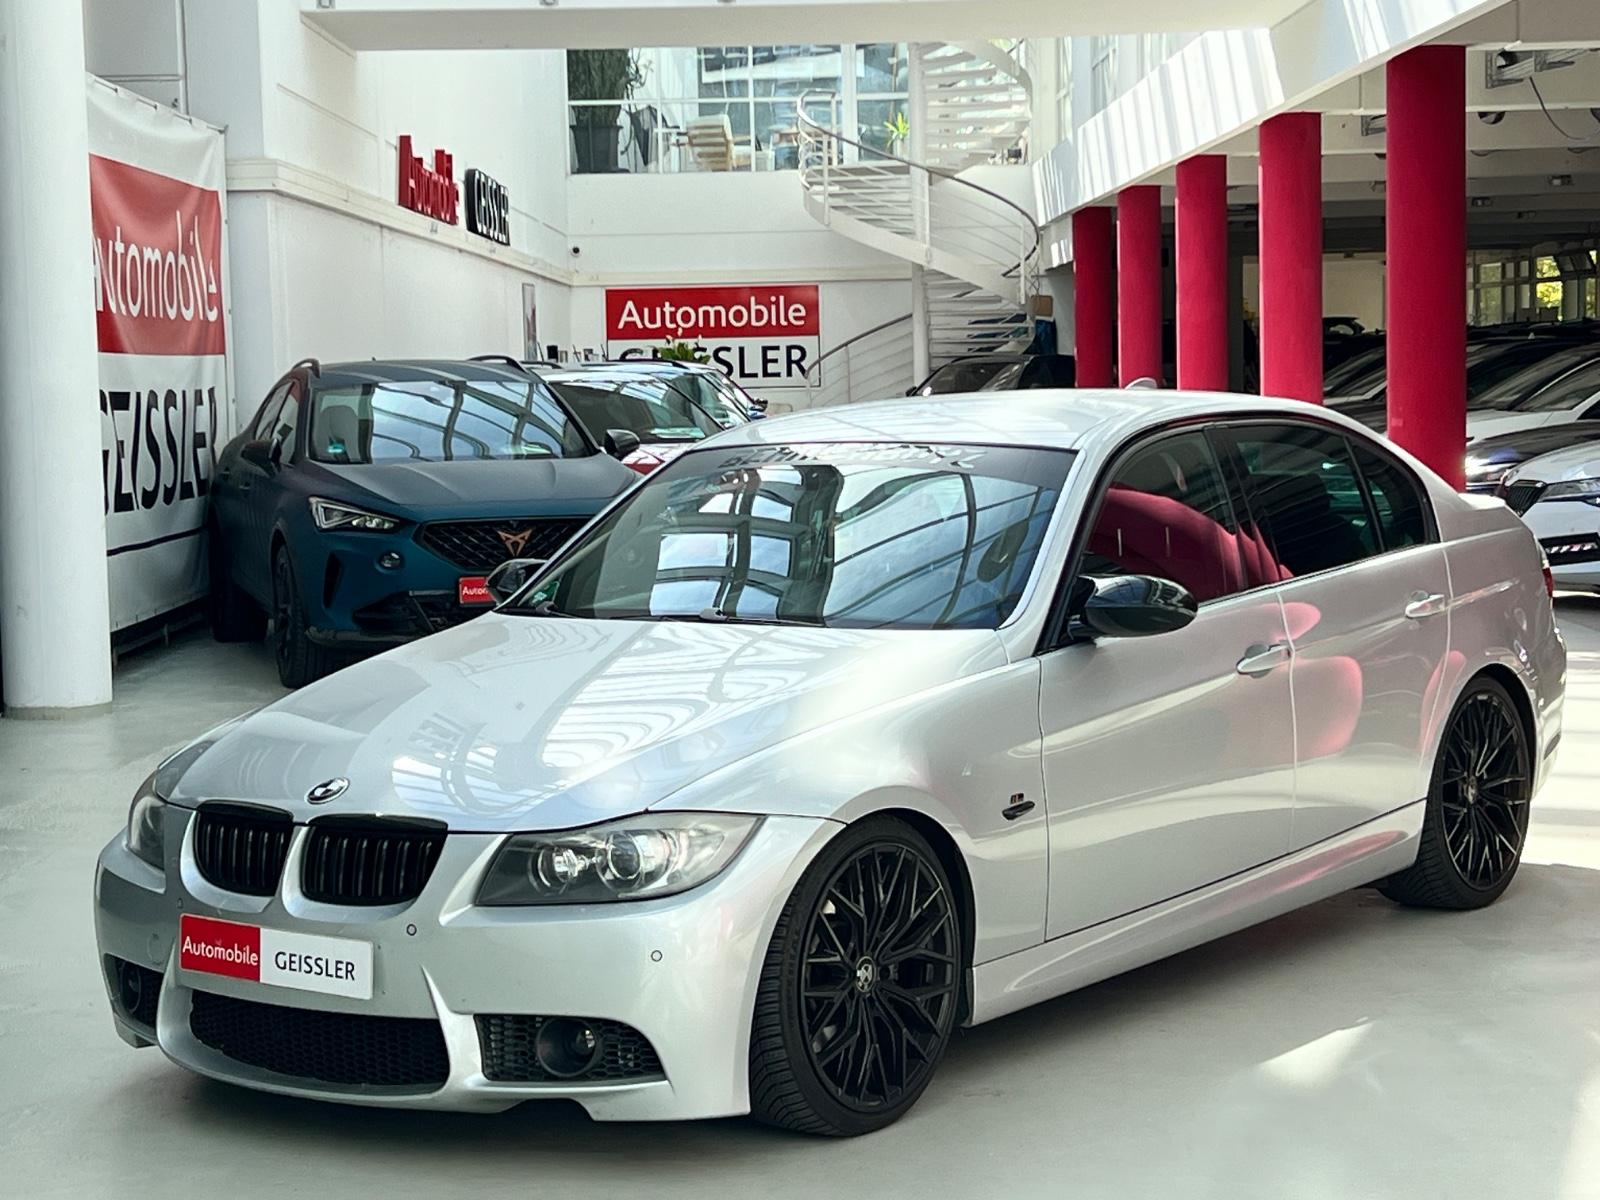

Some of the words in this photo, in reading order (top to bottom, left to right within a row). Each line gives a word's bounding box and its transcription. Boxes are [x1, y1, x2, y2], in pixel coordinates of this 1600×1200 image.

[617, 295, 807, 329] Automobile
[182, 935, 259, 966] Automobile
[274, 951, 355, 981] GEISSLER
